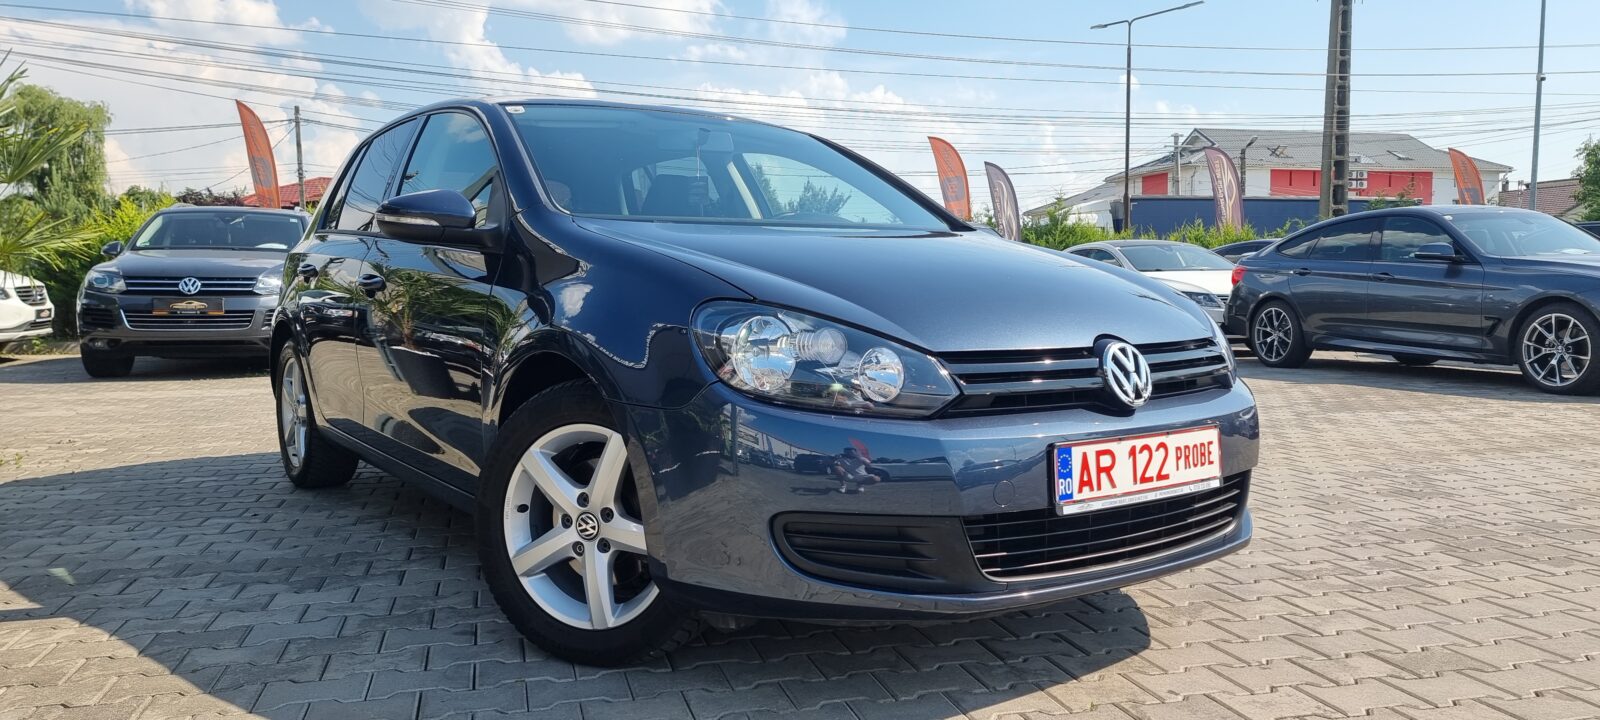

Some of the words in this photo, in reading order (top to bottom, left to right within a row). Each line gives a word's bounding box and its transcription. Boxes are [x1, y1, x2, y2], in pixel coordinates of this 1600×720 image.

[1078, 448, 1117, 494] AR
[1128, 441, 1170, 486] 122
[1175, 440, 1214, 471] PROBE
[1059, 478, 1073, 496] RO
